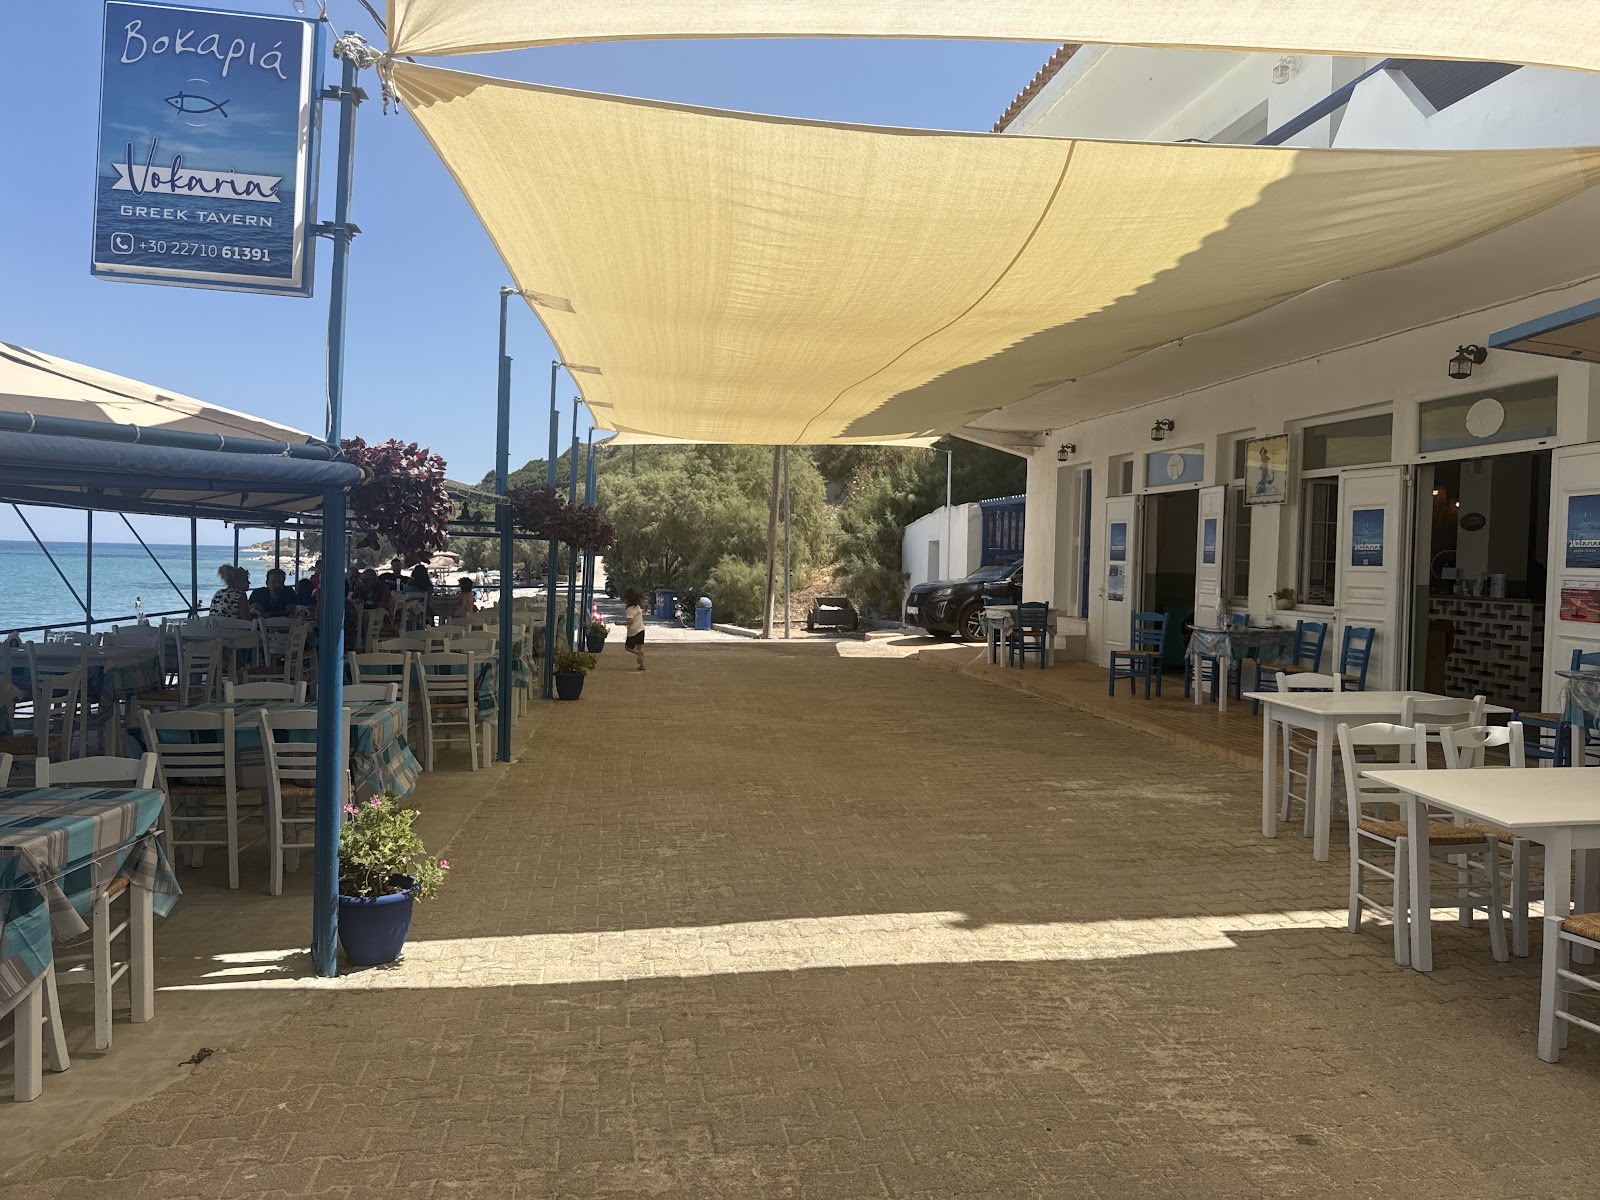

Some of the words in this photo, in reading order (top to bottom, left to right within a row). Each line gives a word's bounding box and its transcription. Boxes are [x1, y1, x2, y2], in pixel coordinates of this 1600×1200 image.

[120, 19, 287, 80] Βοκαριά
[125, 136, 280, 197] Vokaria
[120, 205, 188, 221] GREEK
[196, 211, 273, 228] TAVERN
[139, 239, 167, 254] +30
[170, 241, 218, 257] 22710
[221, 246, 271, 262] 61391
